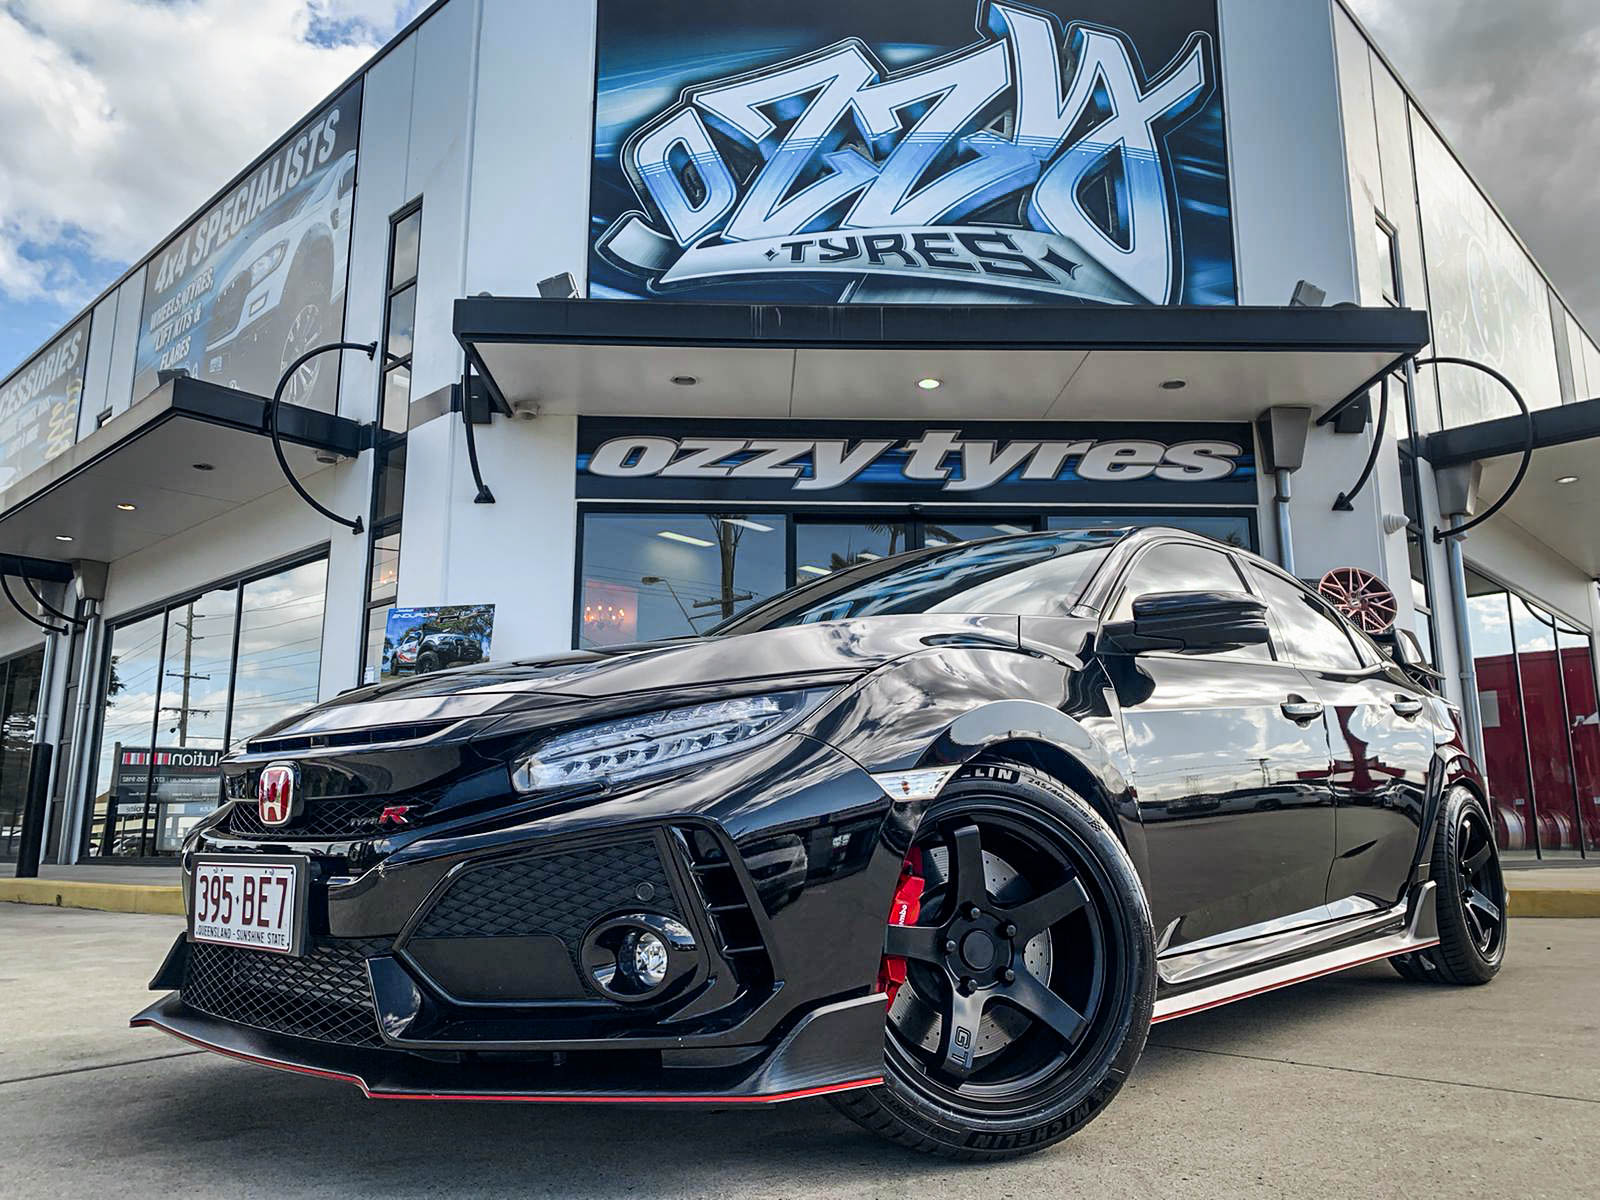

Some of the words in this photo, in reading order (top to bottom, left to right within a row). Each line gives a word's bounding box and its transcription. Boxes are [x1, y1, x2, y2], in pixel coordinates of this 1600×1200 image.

[191, 109, 340, 266] SPECIALISTS
[782, 232, 1037, 282] TYRES
[587, 434, 899, 490] ozzy
[902, 428, 1243, 492] tyres
[196, 925, 232, 939] QUEENSLAND
[236, 929, 265, 944] SUNSHINE
[267, 932, 285, 946] STATE
[972, 1101, 1092, 1149] MICHELIN
